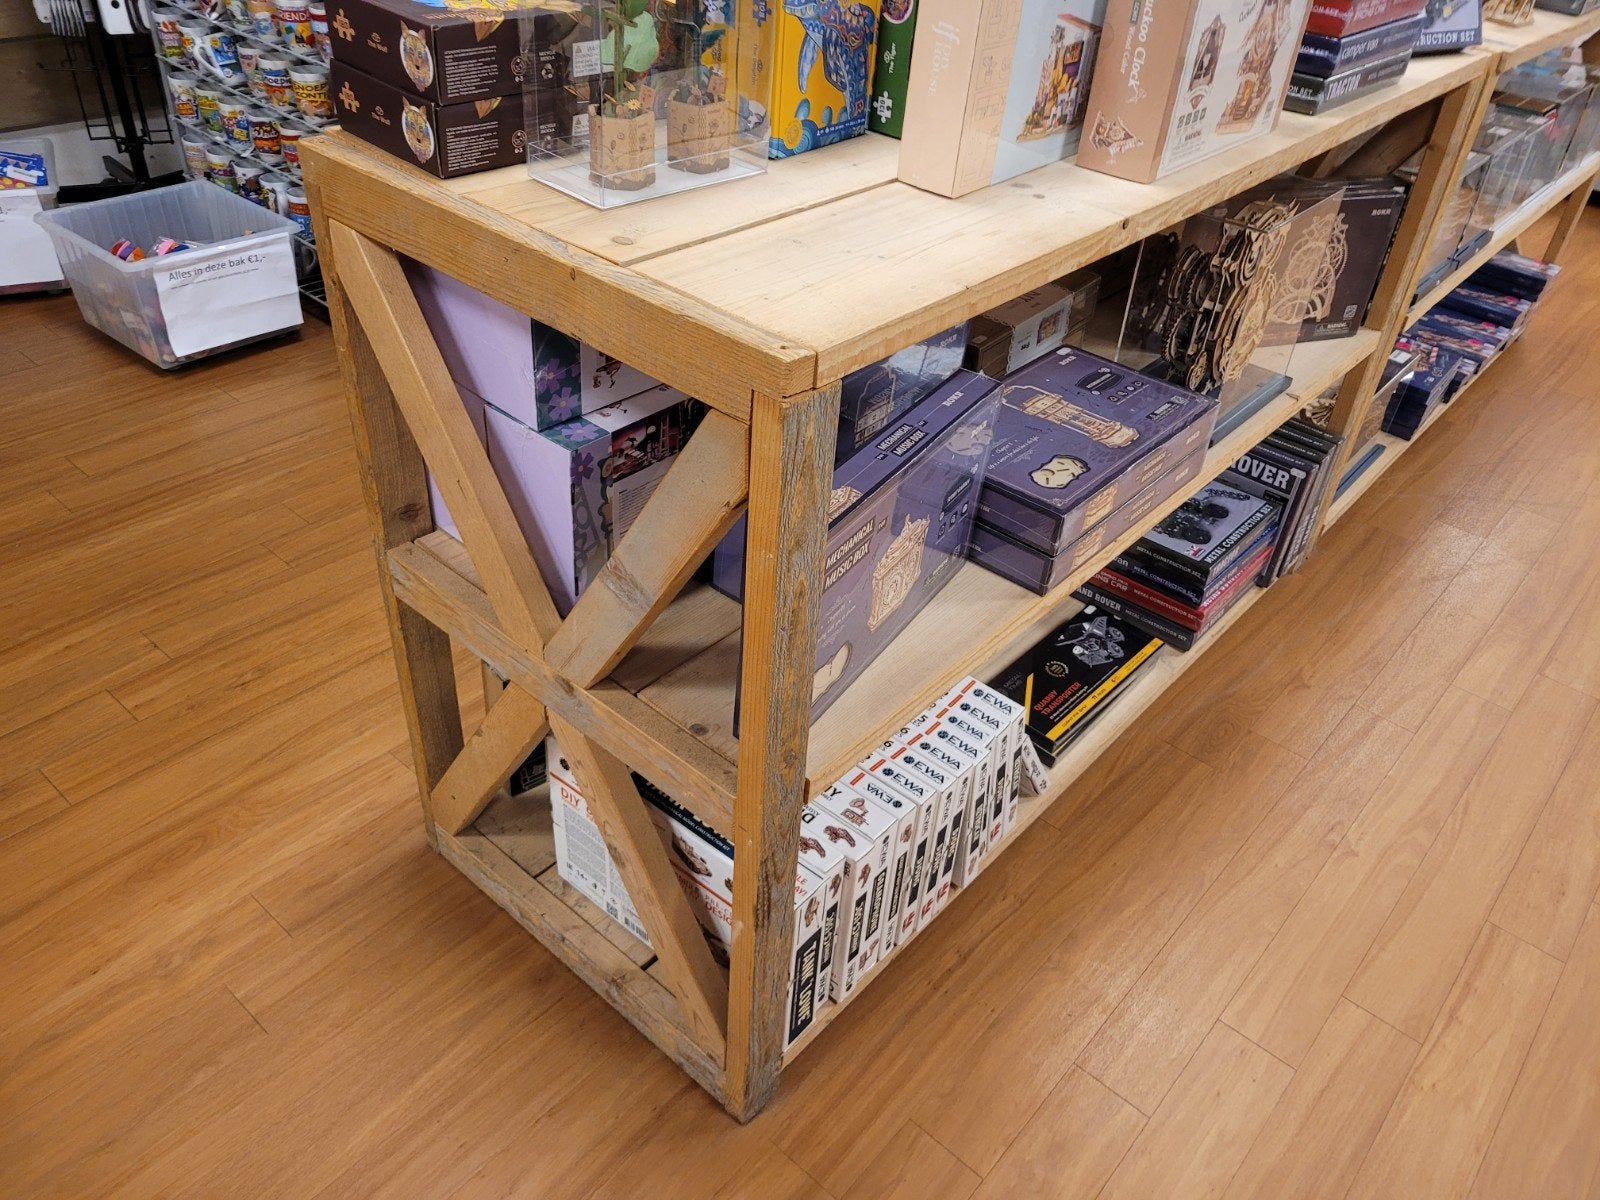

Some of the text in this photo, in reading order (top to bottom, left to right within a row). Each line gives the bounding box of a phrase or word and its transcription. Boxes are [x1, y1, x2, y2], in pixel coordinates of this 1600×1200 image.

[1460, 31, 1475, 42] SET
[1128, 46, 1146, 89] Clock
[169, 271, 192, 281] Alles
[194, 268, 203, 276] in
[205, 262, 226, 273] deze
[228, 257, 246, 267] bak
[877, 424, 913, 451] MECHANICAL
[892, 429, 926, 456] MUSIC BOX
[826, 519, 874, 570] MECHANICAL
[1204, 504, 1273, 564] METAL CONSTRUCTION SET
[825, 541, 870, 590] MUSIC BOX
[1110, 578, 1128, 592] CAR
[1094, 593, 1122, 611] ROVER
[1141, 617, 1178, 637] CONSTRUCTION
[1177, 633, 1188, 641] SET
[983, 693, 1013, 714] EWA
[1034, 690, 1058, 711] QUARRY
[1041, 681, 1081, 716] TRANSPORTER
[970, 707, 1000, 729] EWA
[957, 721, 983, 740] EWA
[883, 740, 895, 748] 6
[948, 735, 978, 758] EWA
[930, 748, 961, 770] EWA
[914, 761, 945, 784] EWA
[866, 783, 893, 803] EWA
[893, 774, 924, 796] EWA
[561, 786, 580, 807] DIY
[694, 824, 723, 846] CONSTRUCTION
[801, 940, 817, 987] TANK
